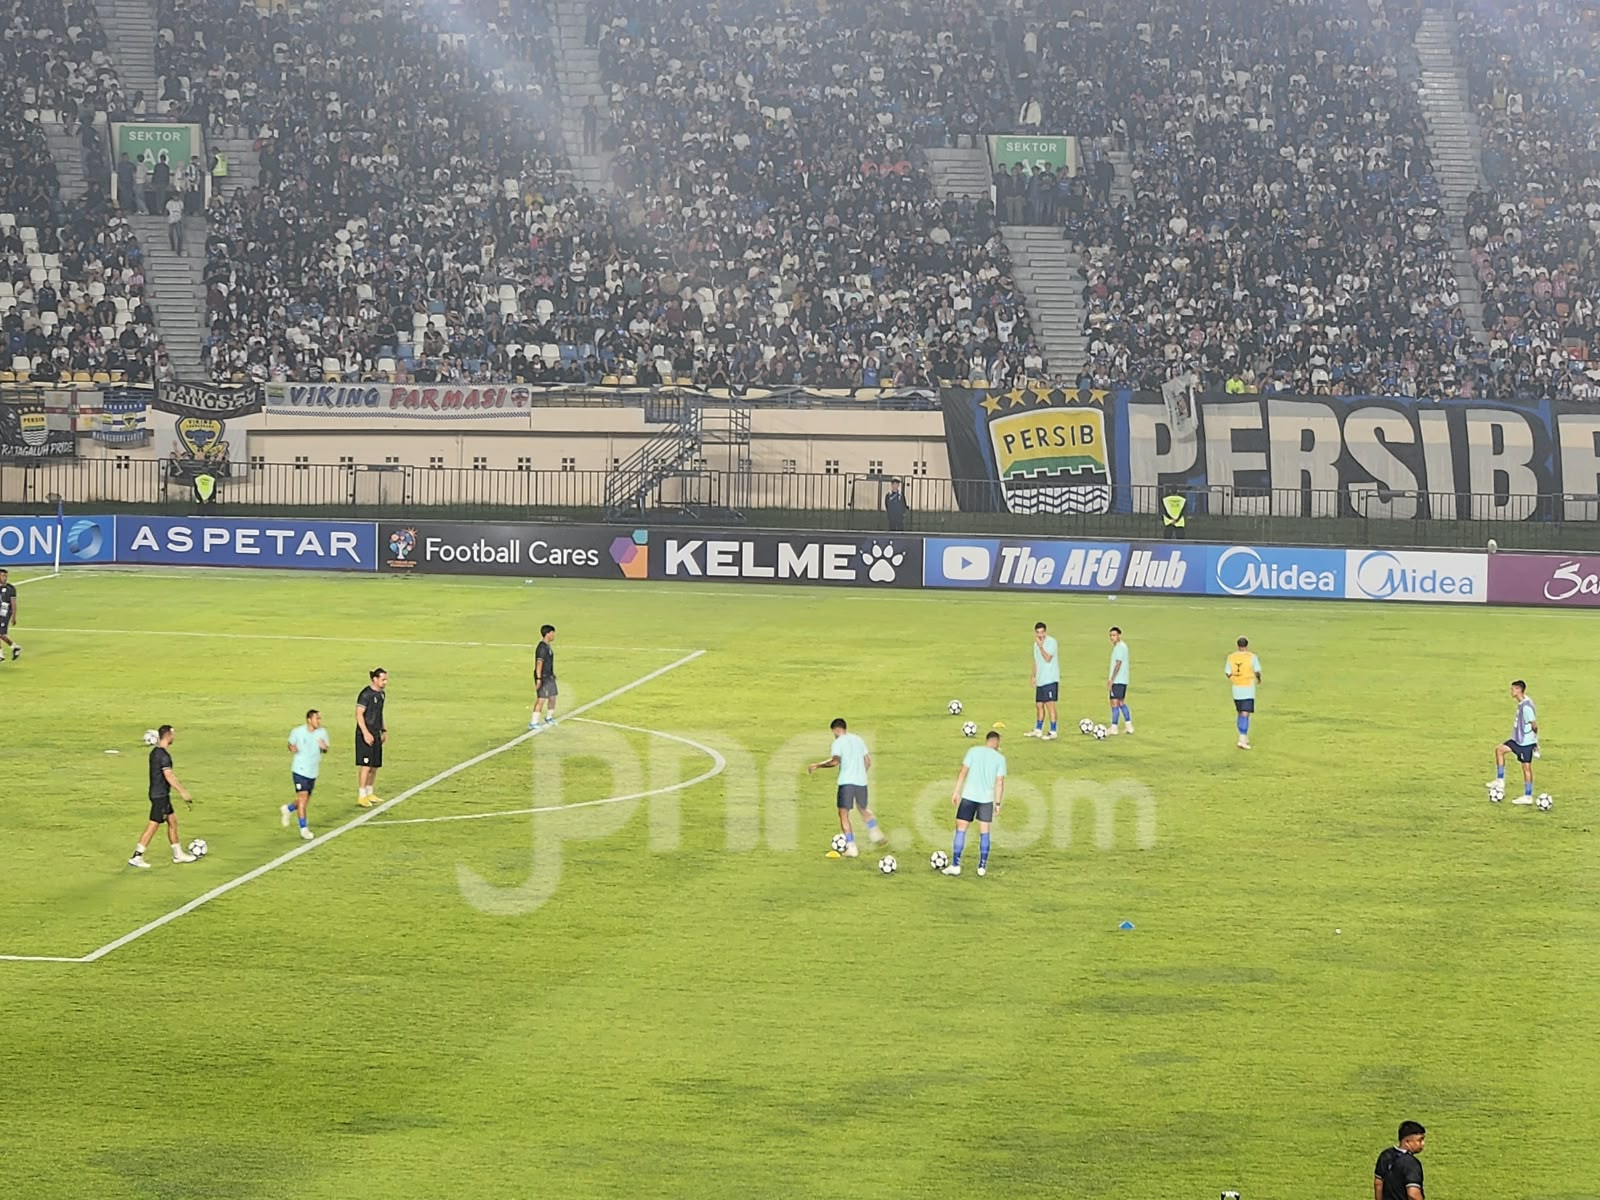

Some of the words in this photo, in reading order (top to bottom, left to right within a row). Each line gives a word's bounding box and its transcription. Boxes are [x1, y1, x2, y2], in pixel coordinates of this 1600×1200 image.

[128, 130, 182, 142] SEKTOR
[1006, 142, 1058, 153] SEKTOR
[289, 386, 382, 408] VIKING
[389, 387, 508, 411] FARMASI
[1002, 424, 1095, 455] PERSIB
[1128, 399, 1539, 521] PERSIB
[131, 525, 361, 563] ASPETAR
[425, 537, 521, 564] Football
[528, 540, 600, 566] Cares
[665, 540, 856, 581] KELME
[998, 547, 1056, 585] The
[1060, 549, 1122, 587] AFC
[1124, 550, 1188, 589] Hub
[1233, 562, 1335, 592] Midea
[1376, 567, 1474, 596] Midea
